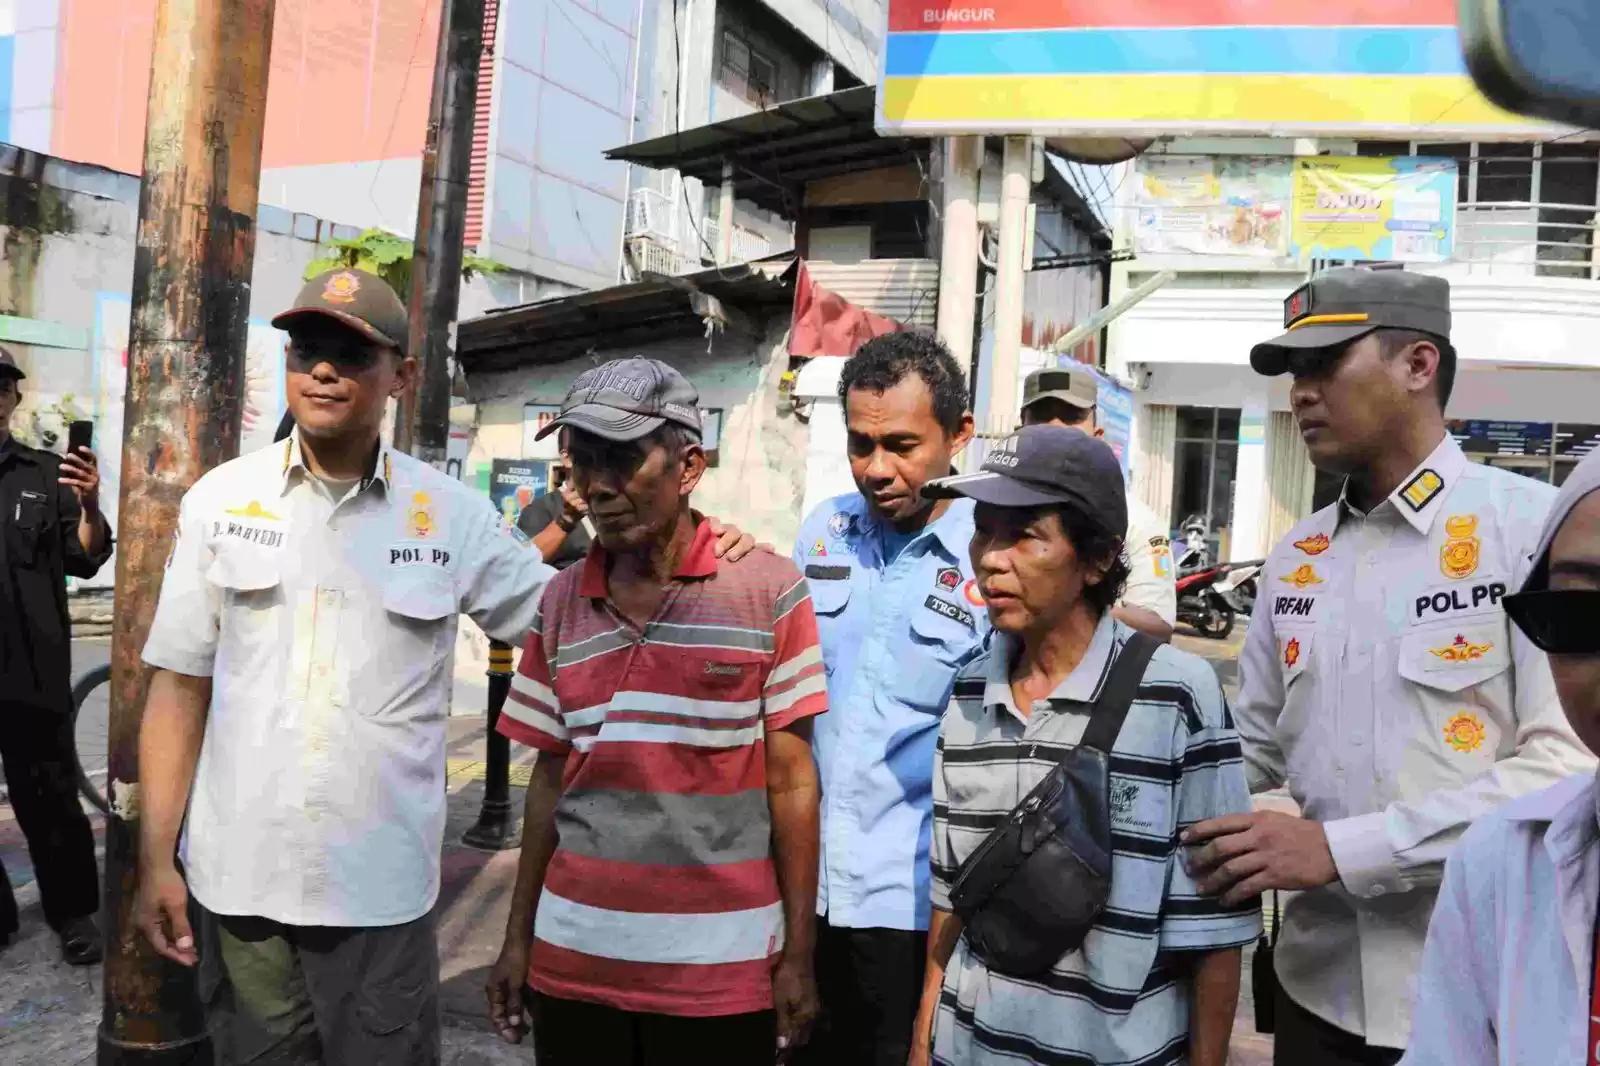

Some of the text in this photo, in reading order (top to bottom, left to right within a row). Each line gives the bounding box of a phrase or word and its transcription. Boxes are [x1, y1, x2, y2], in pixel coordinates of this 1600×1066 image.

[923, 8, 996, 23] BUNGUR
[390, 548, 450, 566] POL PP
[932, 598, 956, 616] TRC
[1275, 596, 1315, 616] IRFAN
[1416, 582, 1506, 617] POL PP
